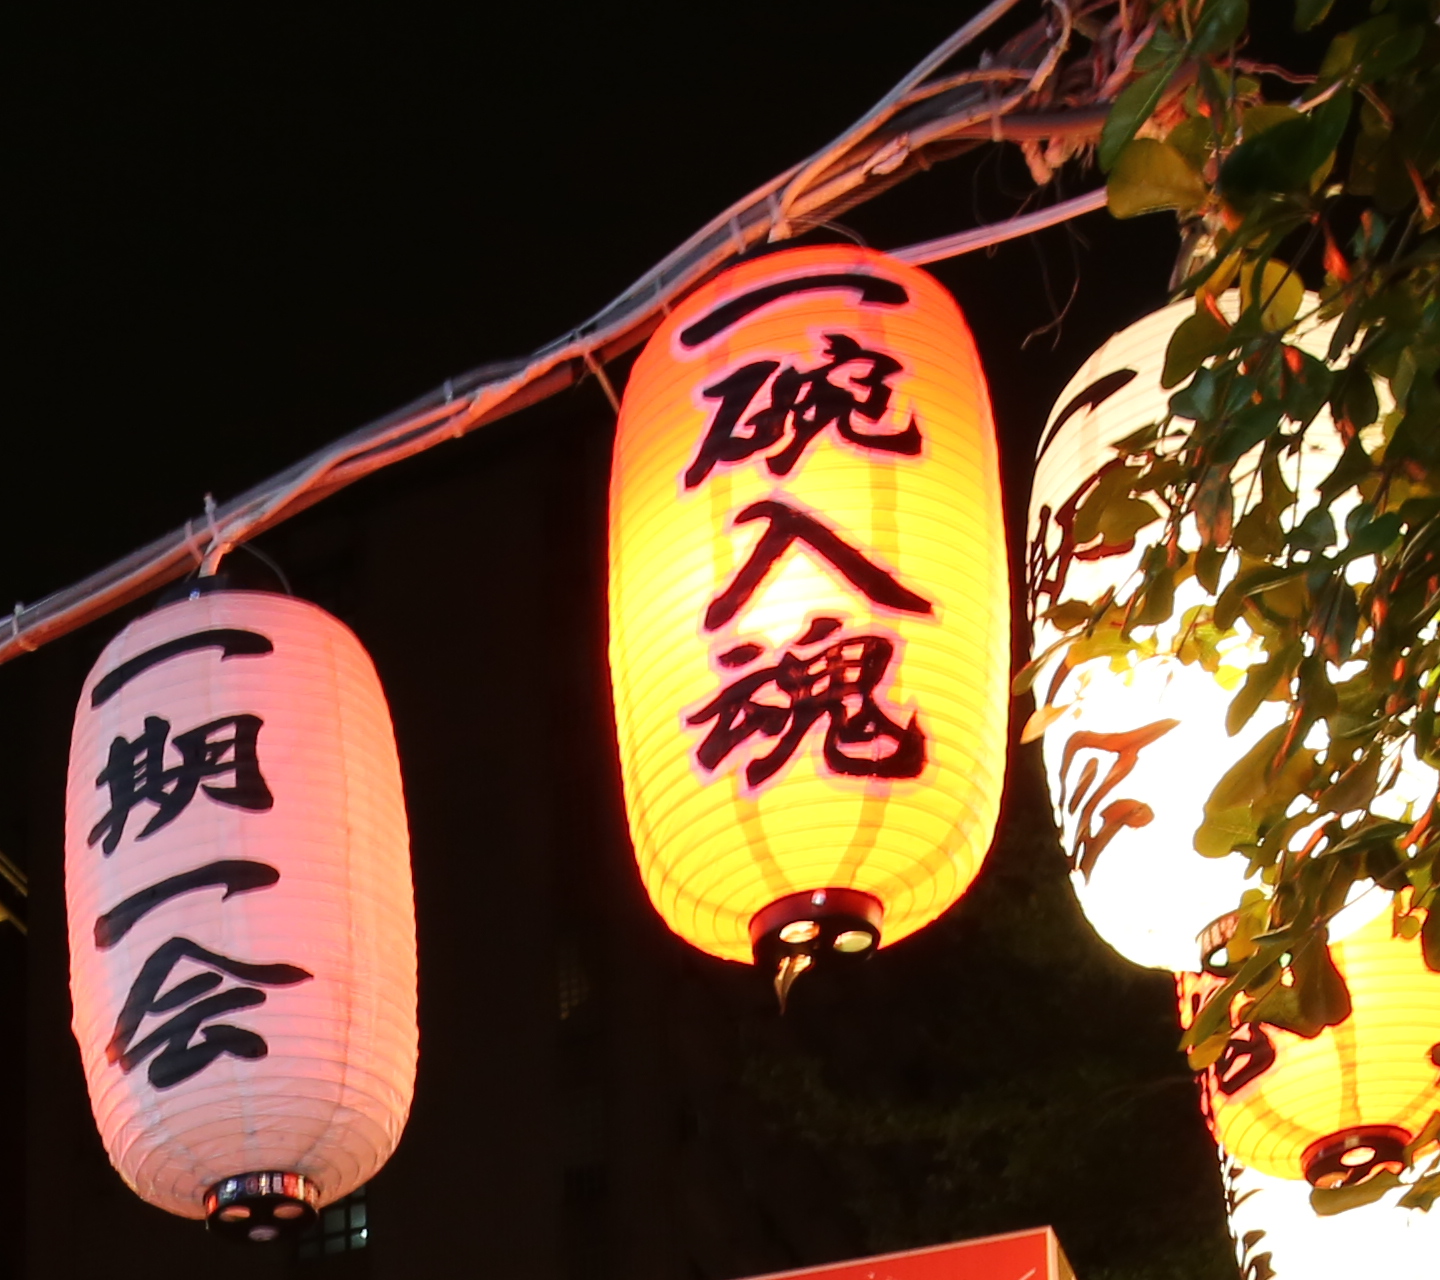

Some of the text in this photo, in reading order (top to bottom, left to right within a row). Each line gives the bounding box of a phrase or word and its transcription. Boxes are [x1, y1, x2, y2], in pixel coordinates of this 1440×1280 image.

[679, 273, 933, 789] 一碗入魂
[88, 627, 312, 1089] 一期一会
